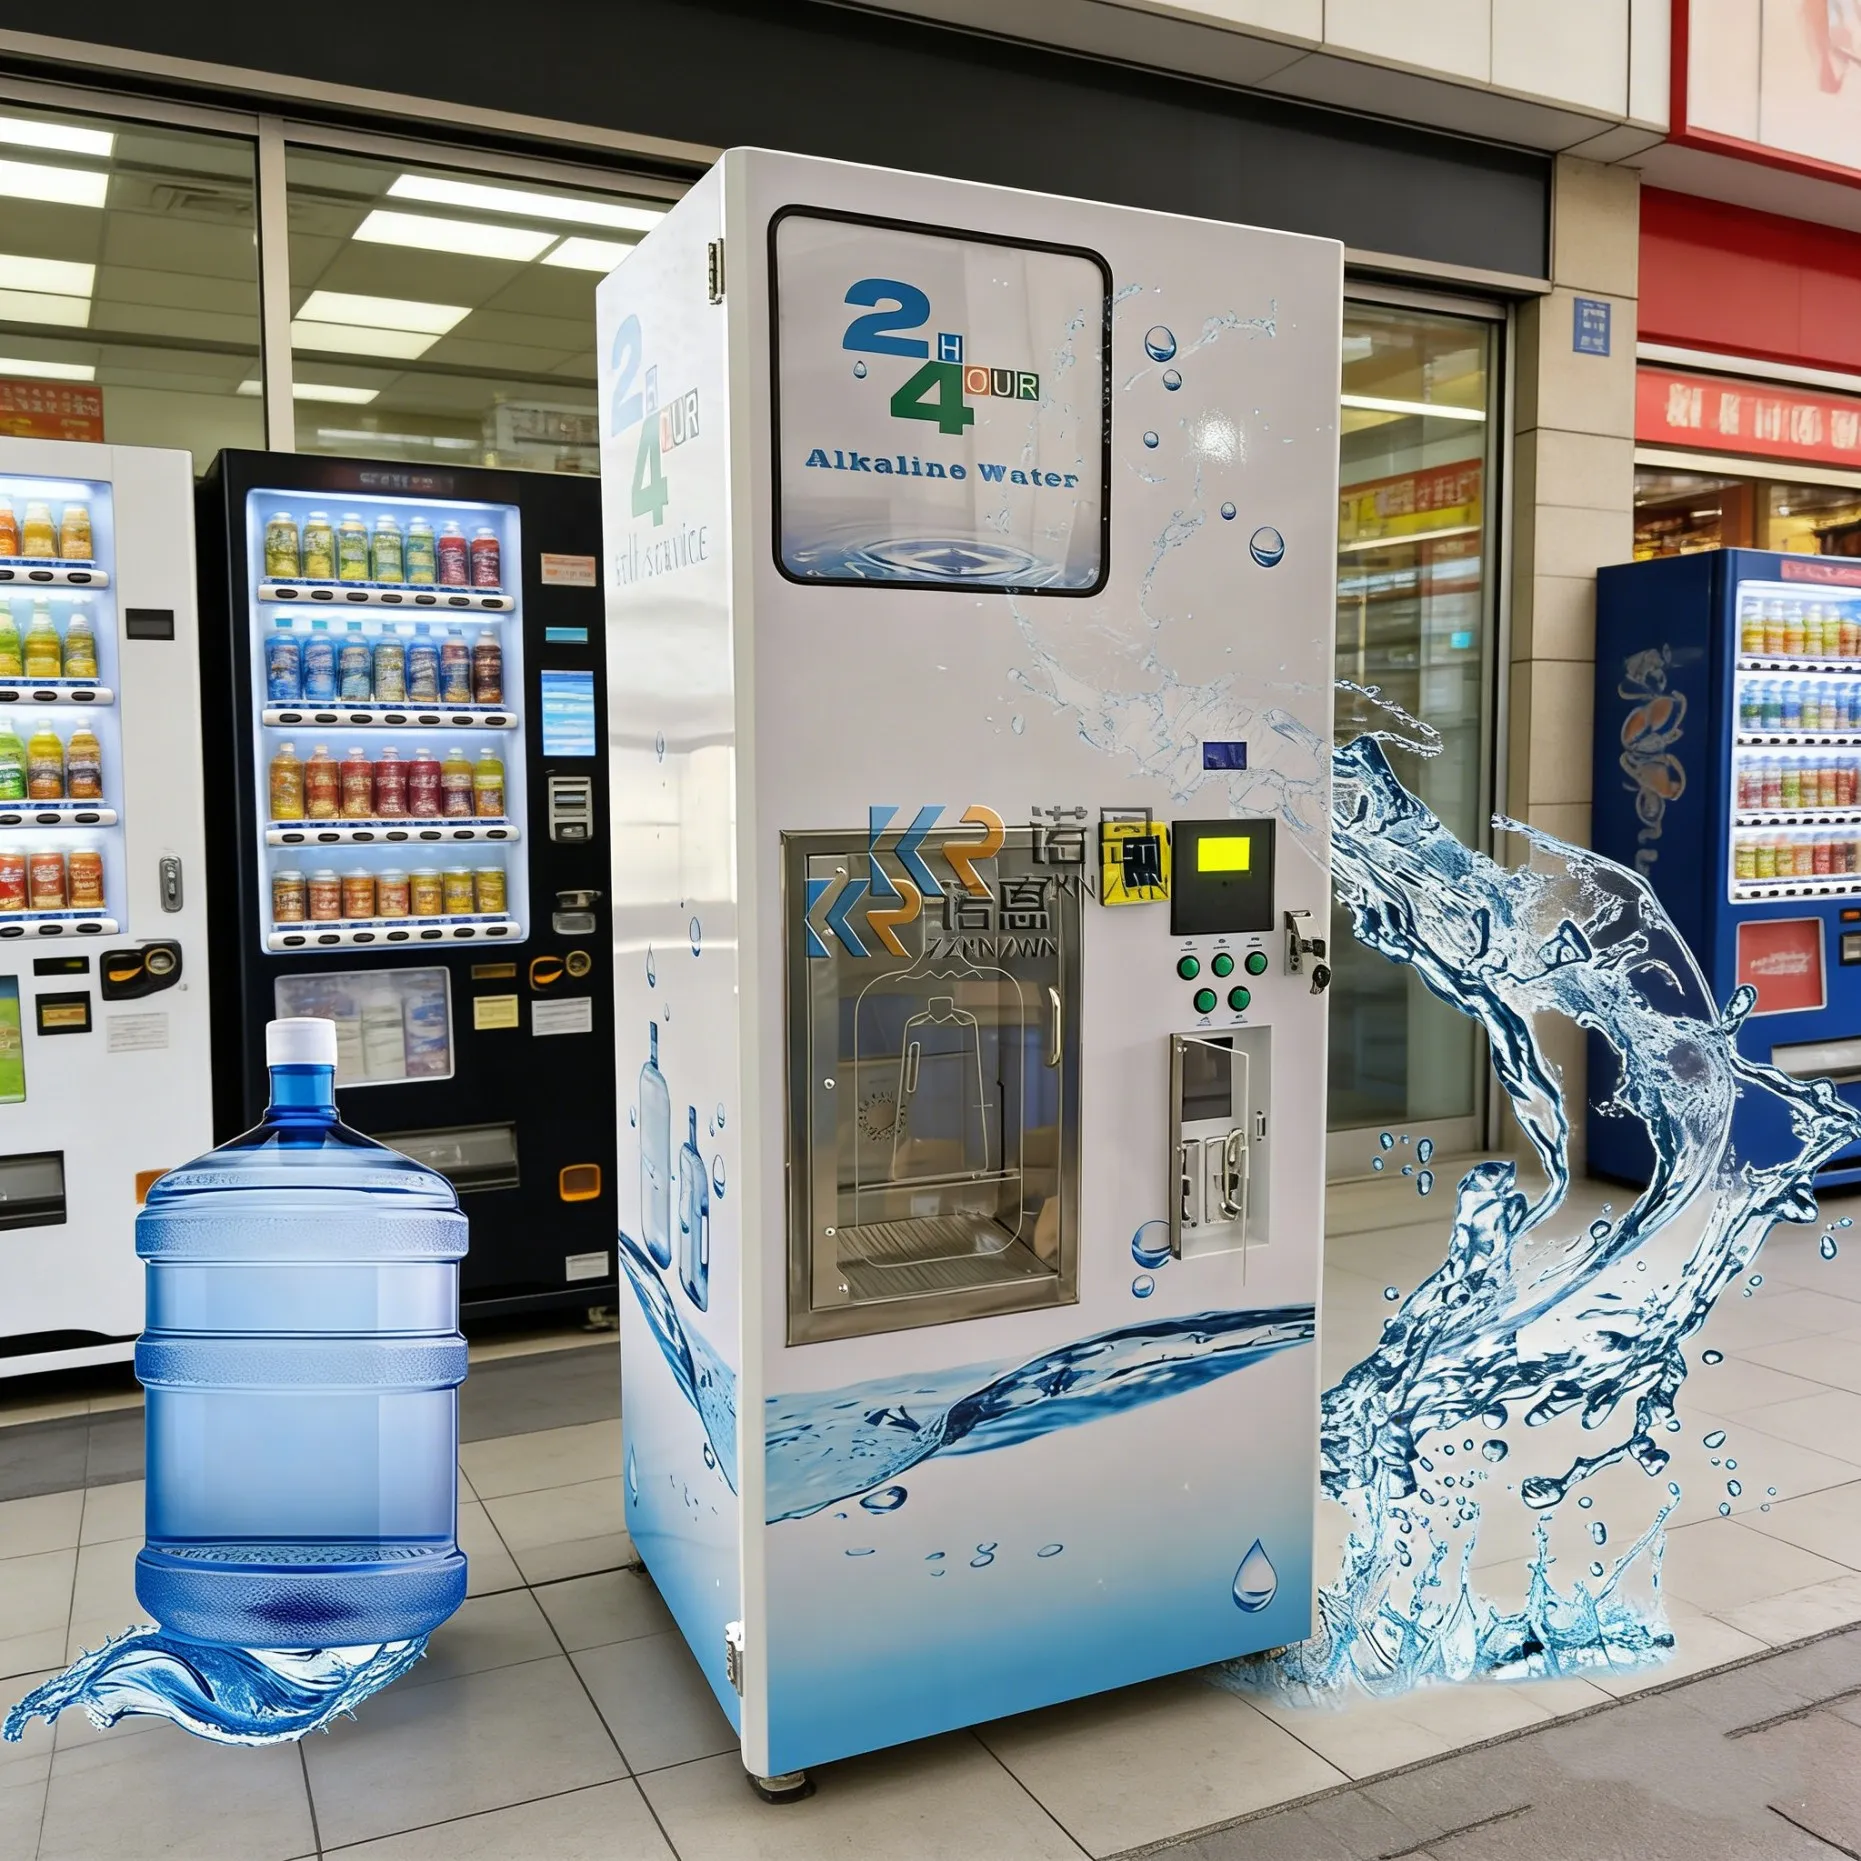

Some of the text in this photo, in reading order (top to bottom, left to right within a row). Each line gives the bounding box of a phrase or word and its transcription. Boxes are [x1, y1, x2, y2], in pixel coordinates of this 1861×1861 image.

[890, 360, 975, 436] 4
[805, 448, 1080, 489] Alkaline Water
